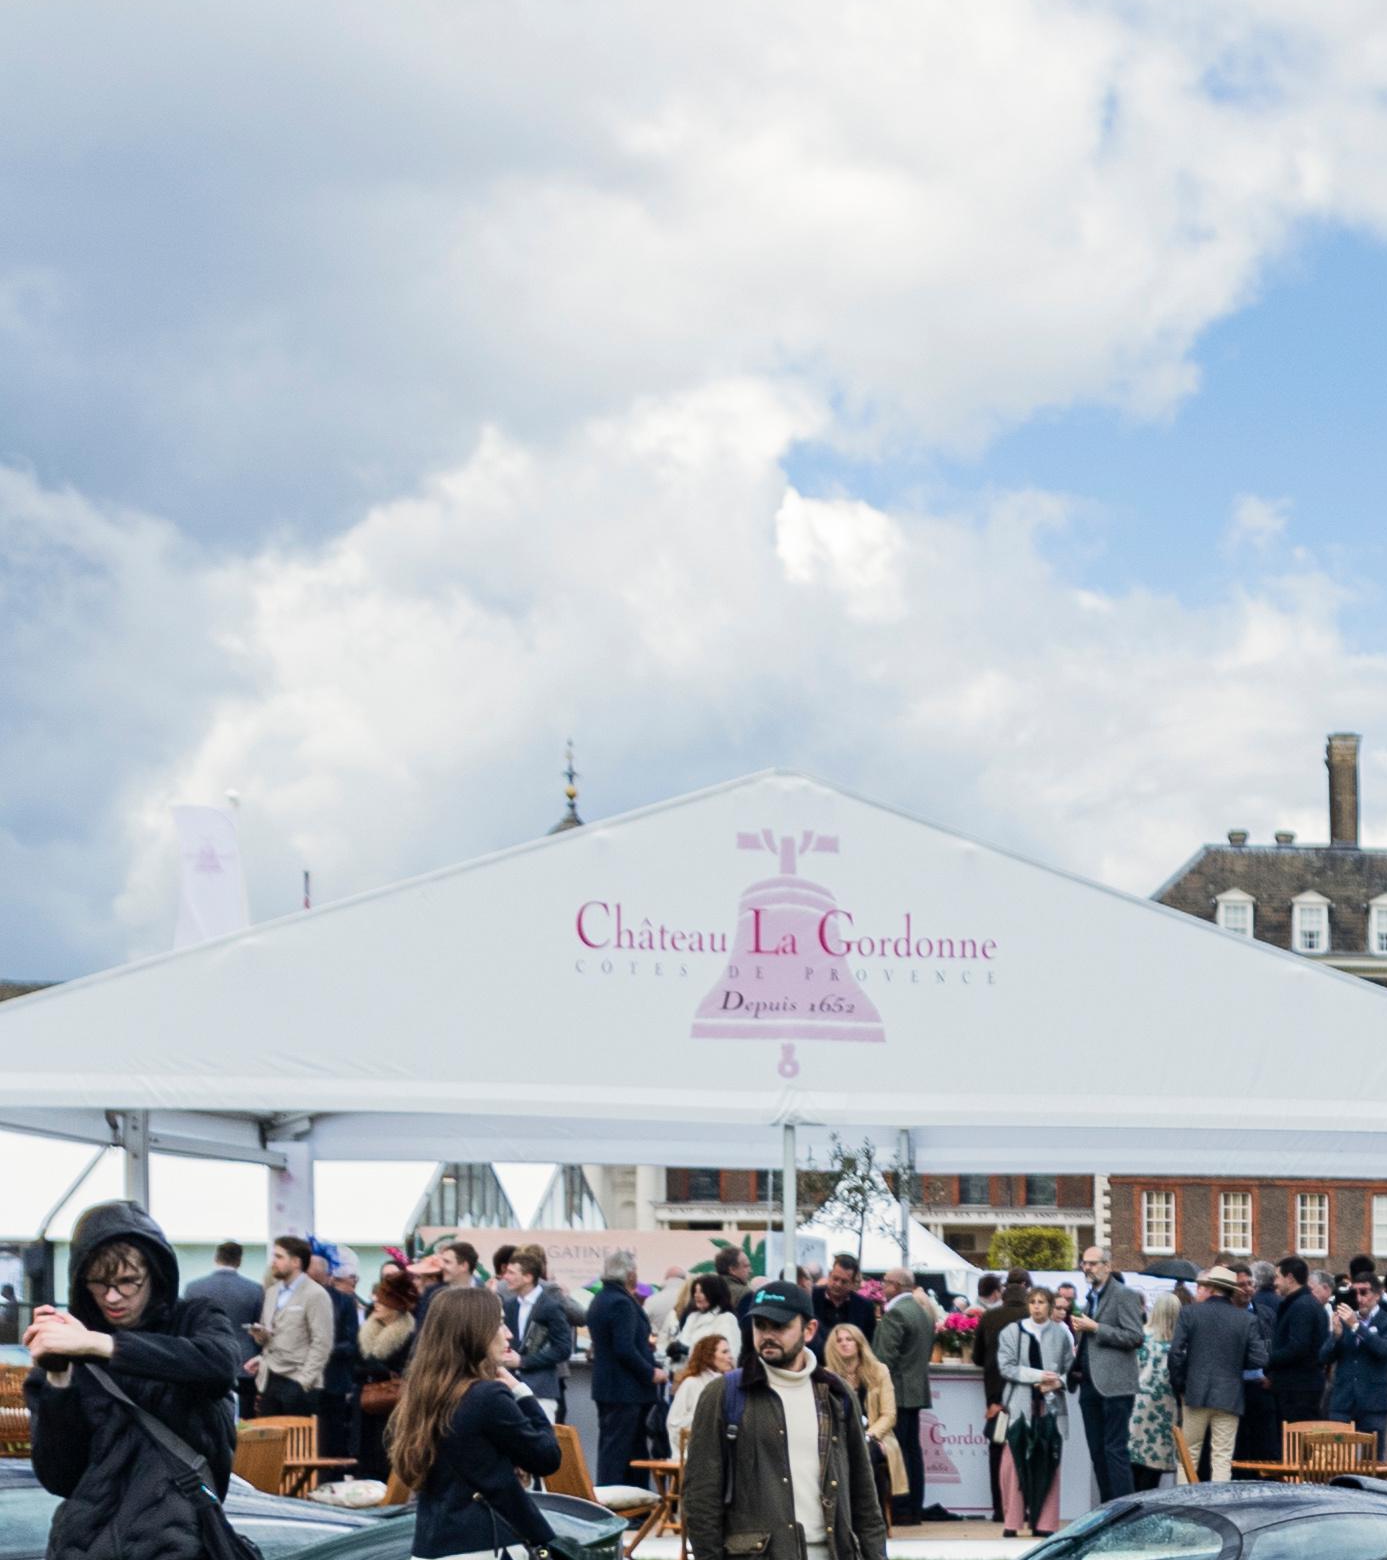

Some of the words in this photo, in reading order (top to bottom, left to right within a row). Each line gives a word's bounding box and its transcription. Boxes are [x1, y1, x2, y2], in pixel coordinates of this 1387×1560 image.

[576, 900, 727, 953] Château
[747, 907, 799, 956] La
[818, 909, 998, 960] Gordonne
[728, 965, 765, 980] DE
[804, 966, 997, 985] PROVENCE
[720, 990, 798, 1019] Depuis
[809, 993, 856, 1015] 1652
